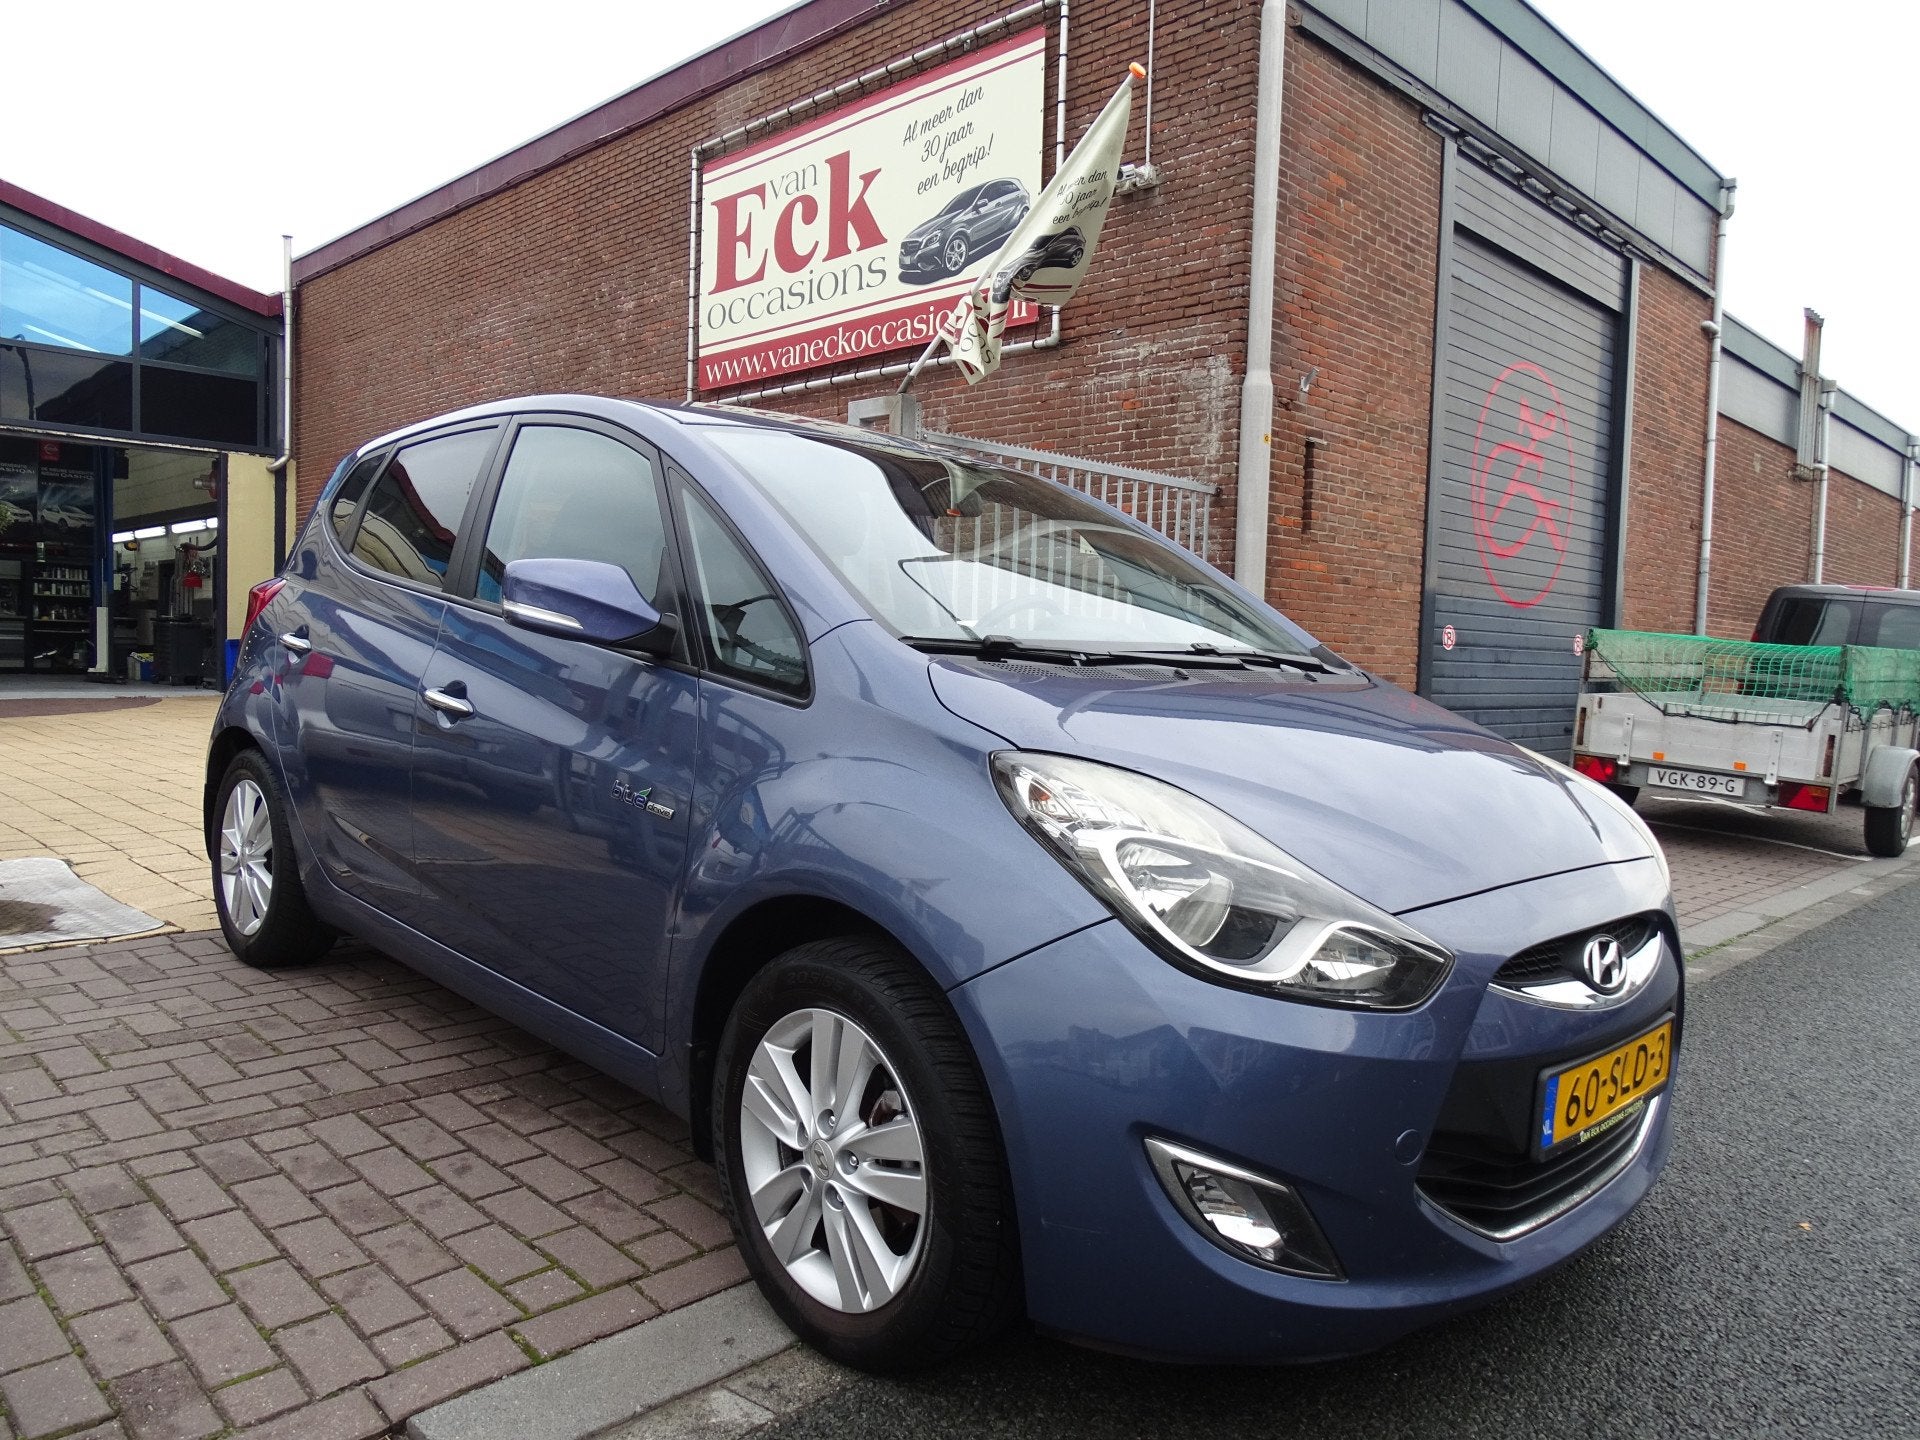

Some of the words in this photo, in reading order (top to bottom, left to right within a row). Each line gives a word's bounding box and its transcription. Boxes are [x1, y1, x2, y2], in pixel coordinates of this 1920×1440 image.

[903, 120, 918, 146] Al
[920, 105, 954, 136] meer
[957, 86, 985, 113] dan
[917, 172, 940, 195] een
[943, 133, 994, 183] begrip!
[921, 135, 941, 162] 30
[940, 121, 974, 163] jaar
[770, 163, 818, 199] van
[1088, 169, 1107, 183] dan
[708, 150, 888, 295] Eck
[1053, 214, 1070, 224] een
[707, 256, 887, 330] occasions
[1657, 770, 1735, 793] VGK-89-G
[1565, 1032, 1666, 1127] 60-SLD-3
